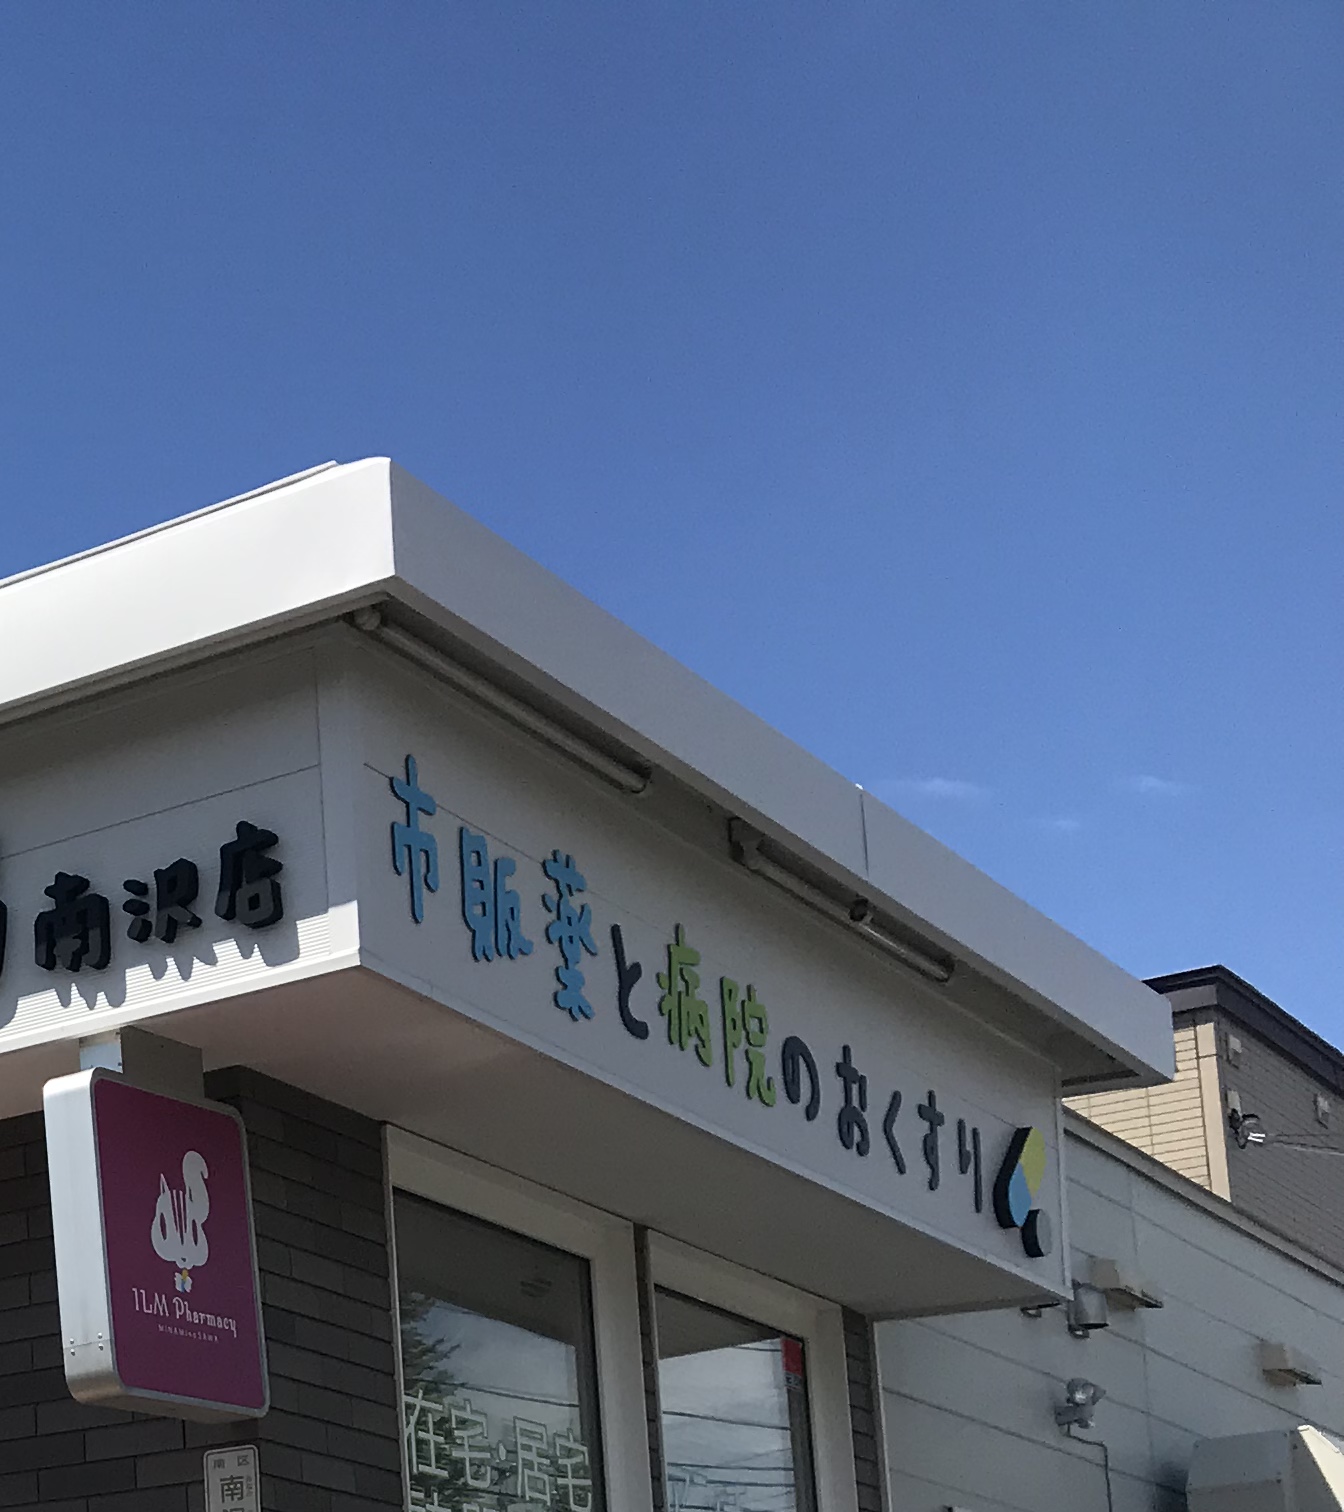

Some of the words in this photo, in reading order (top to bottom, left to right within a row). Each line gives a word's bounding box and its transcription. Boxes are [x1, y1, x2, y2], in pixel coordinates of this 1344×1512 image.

[33, 820, 285, 972] 南沢店
[389, 754, 983, 1213] 市販薬と病院のおくすり
[132, 1287, 169, 1317] ILM
[173, 1297, 237, 1338] Pharmacy
